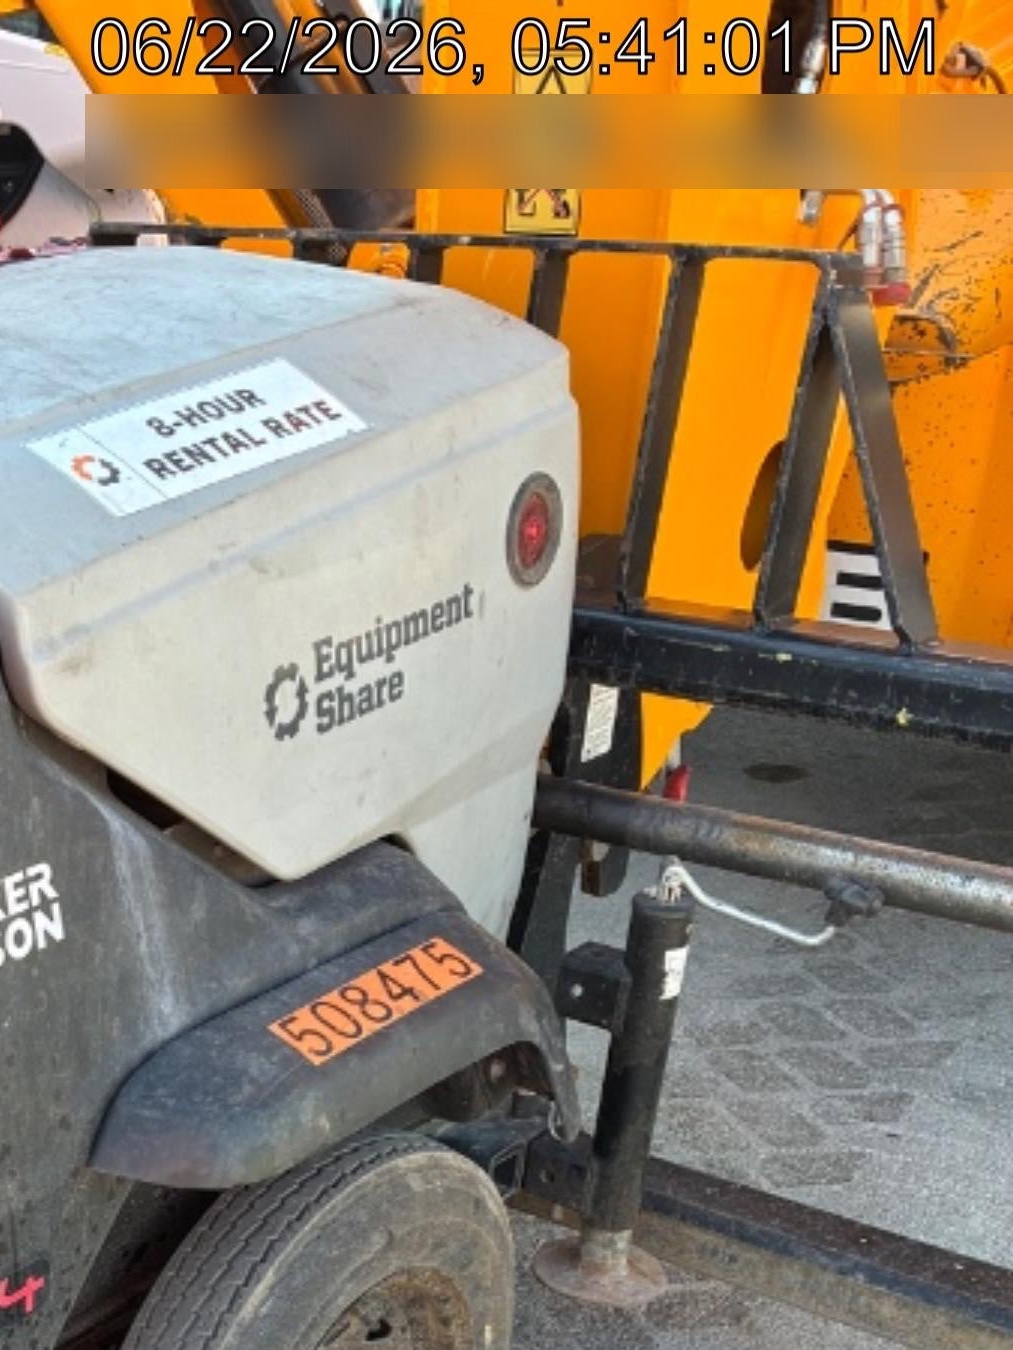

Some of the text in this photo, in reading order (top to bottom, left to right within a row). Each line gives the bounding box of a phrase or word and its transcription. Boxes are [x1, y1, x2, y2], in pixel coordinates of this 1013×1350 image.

[142, 399, 344, 481] RENTAL RATE
[145, 387, 268, 438] 8-HOUR
[312, 580, 475, 684] Equipment
[314, 669, 406, 735] Share
[276, 940, 474, 1057] 508475
